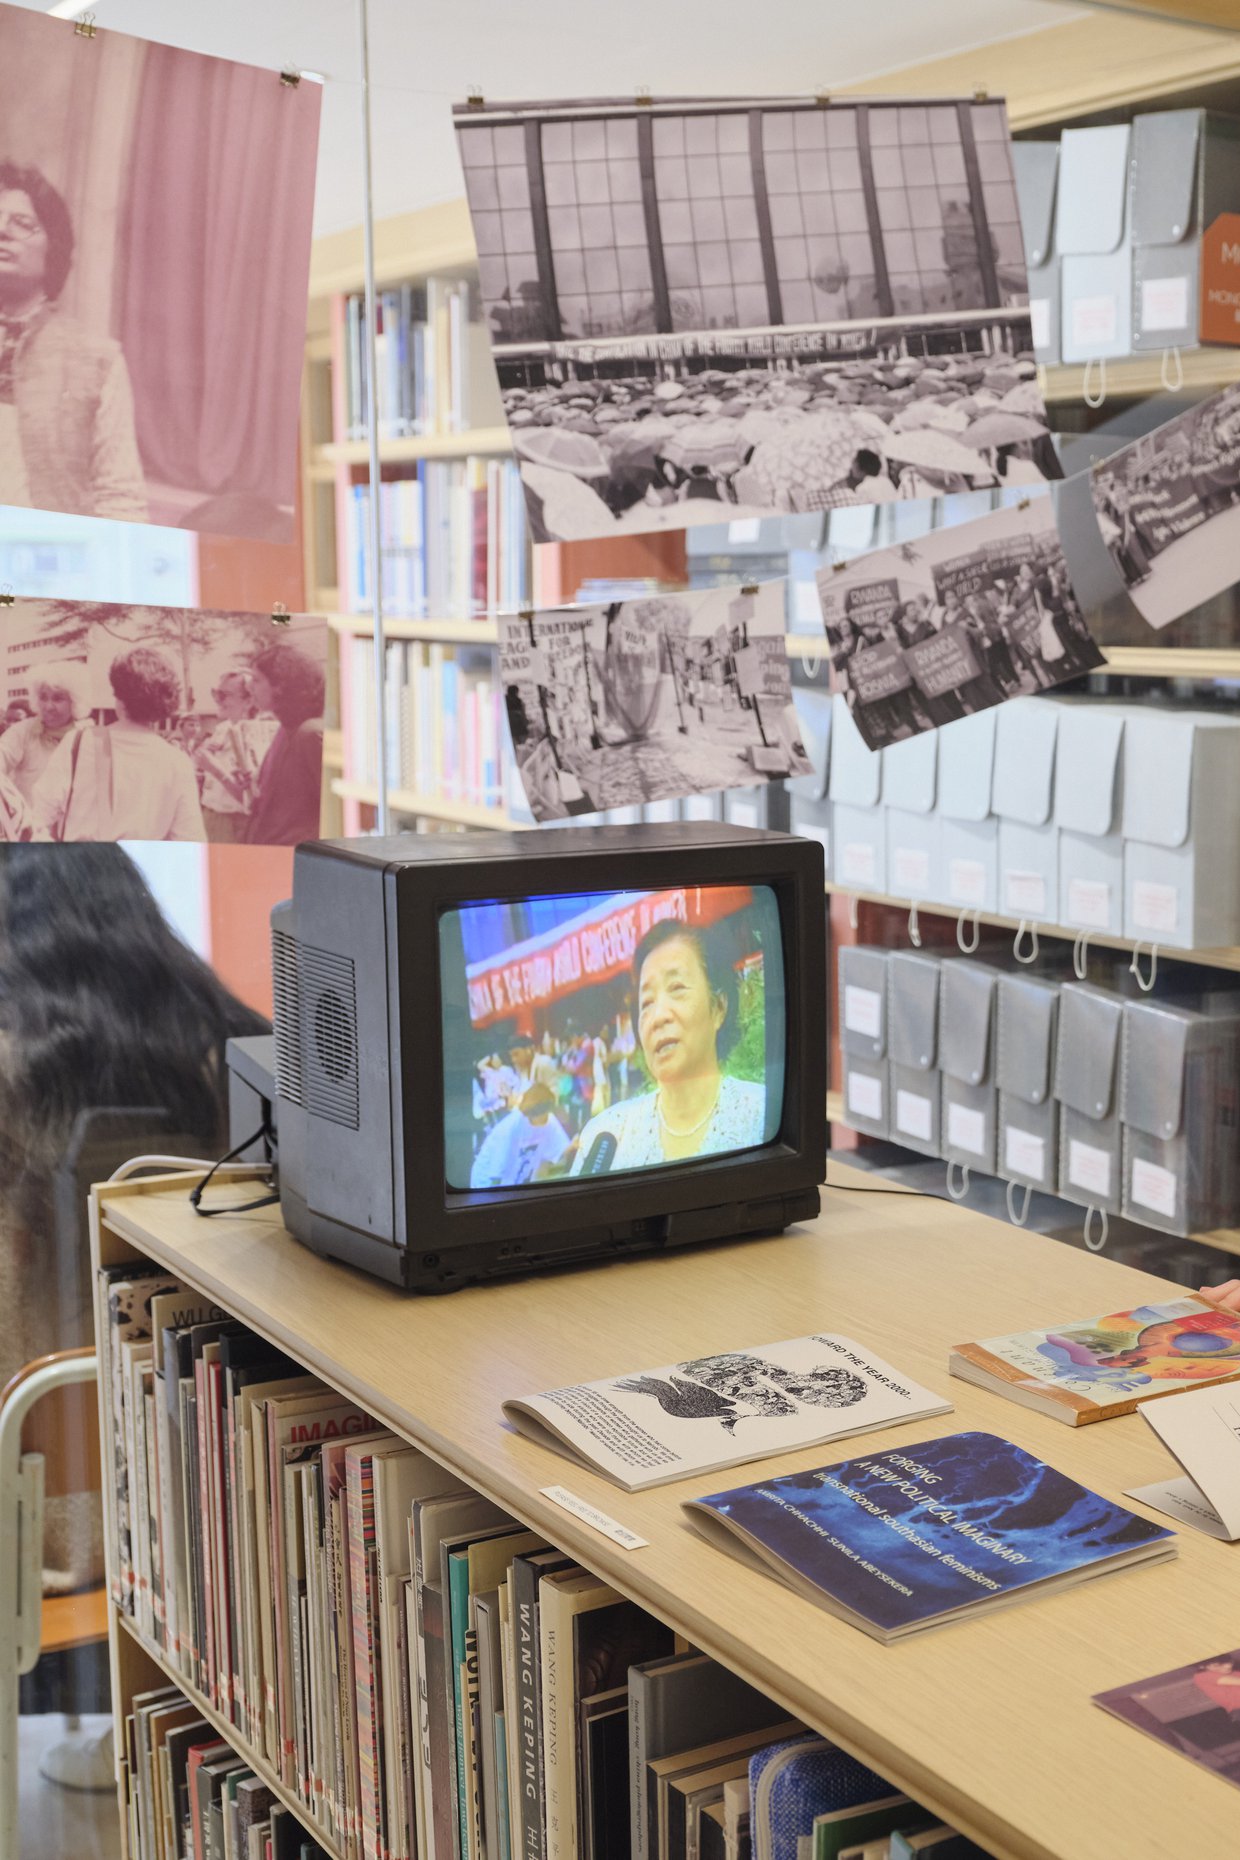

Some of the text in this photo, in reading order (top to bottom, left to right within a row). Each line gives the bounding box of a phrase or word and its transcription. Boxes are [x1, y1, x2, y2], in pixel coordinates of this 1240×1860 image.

[501, 656, 531, 671] AND
[580, 908, 637, 974] CONFERENCE
[172, 1308, 205, 1330] WU
[844, 1352, 866, 1367] THE
[862, 1365, 890, 1384] YEAR
[882, 1453, 943, 1486] FORGING
[754, 1488, 914, 1597] AMRITA CHHACHHI SUNILA ABEYSEKERA
[813, 1472, 1002, 1591] transnational southasian feminisms
[853, 1461, 1033, 1566] A NEW POLITICAL IMAGINARY
[518, 1603, 537, 1799] WANG KEPING
[547, 1629, 557, 1766] WANG KEPING
